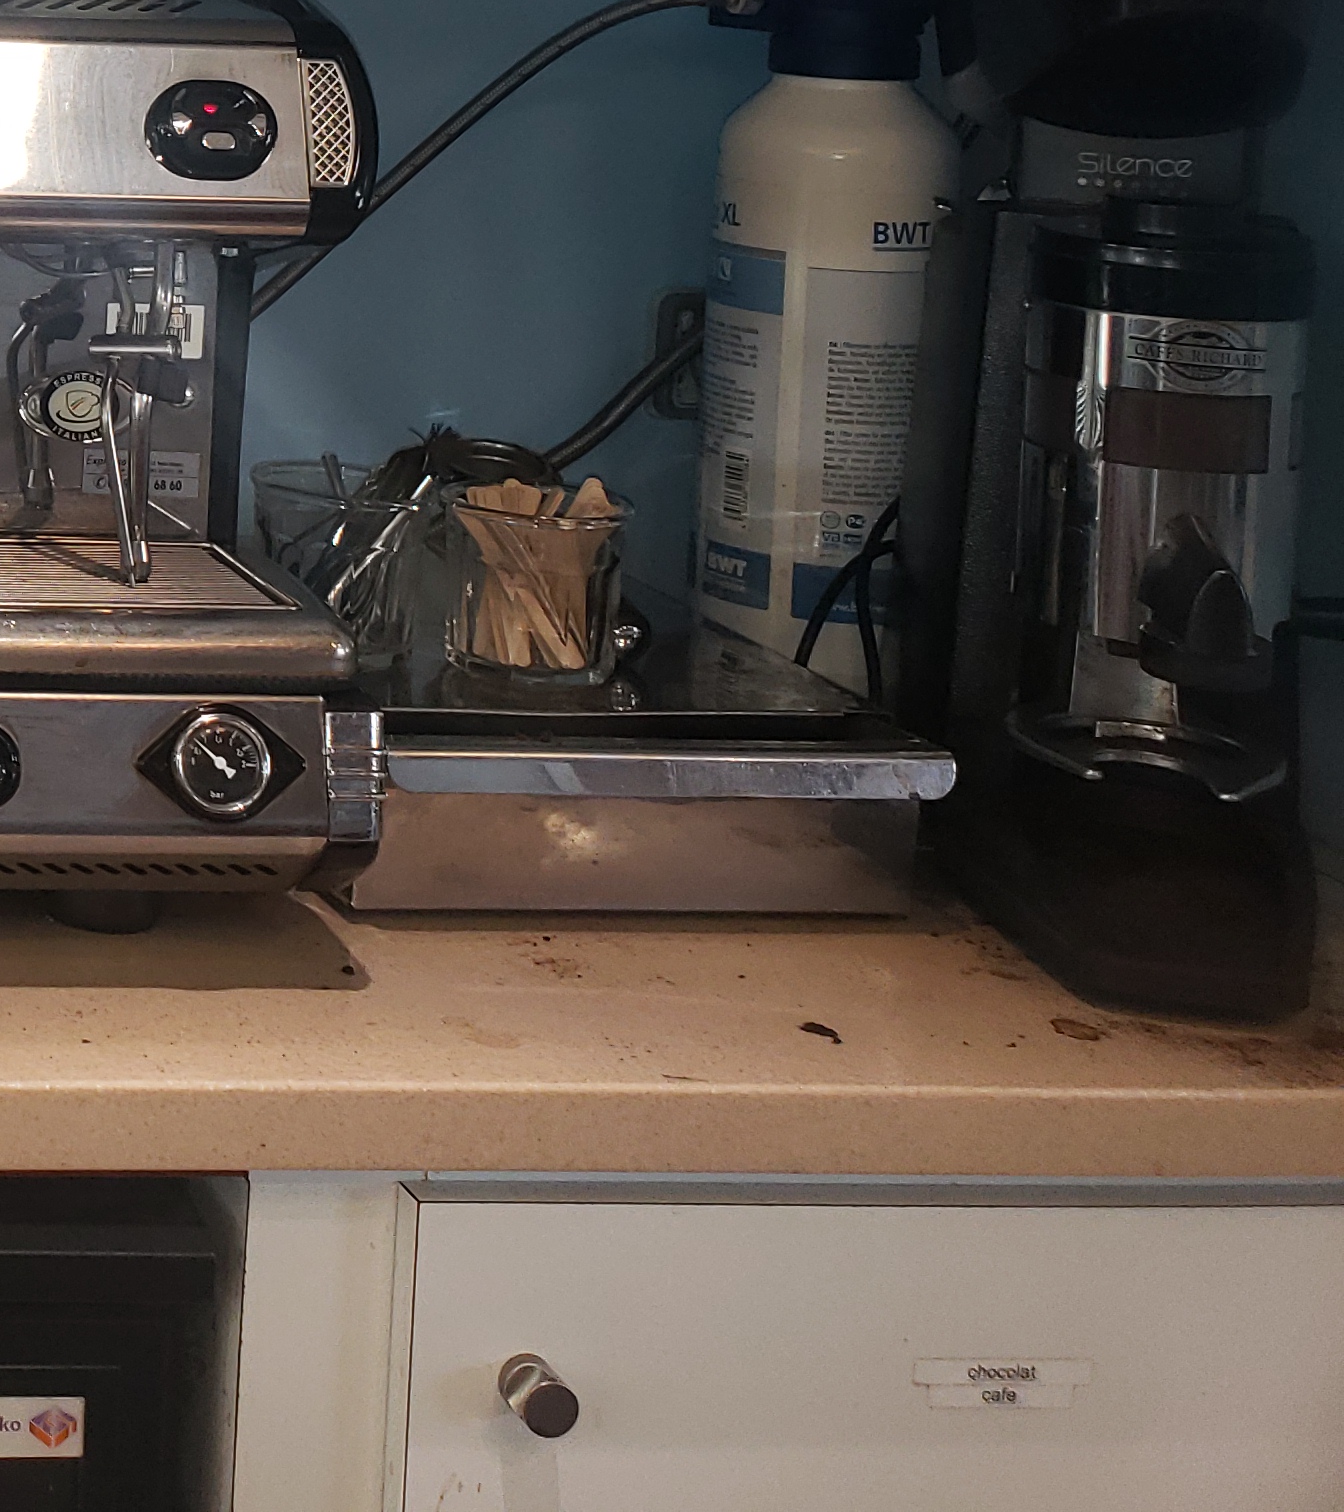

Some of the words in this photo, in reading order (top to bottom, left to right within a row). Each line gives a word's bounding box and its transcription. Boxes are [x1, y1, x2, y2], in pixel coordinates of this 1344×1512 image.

[1077, 152, 1193, 178] Silence
[721, 201, 742, 226] XL
[872, 220, 932, 246] BWT
[1191, 348, 1262, 368] RICHARD
[53, 372, 104, 388] ESPRESS
[52, 424, 103, 442] ITALIAN
[967, 1364, 1037, 1380] chocolat
